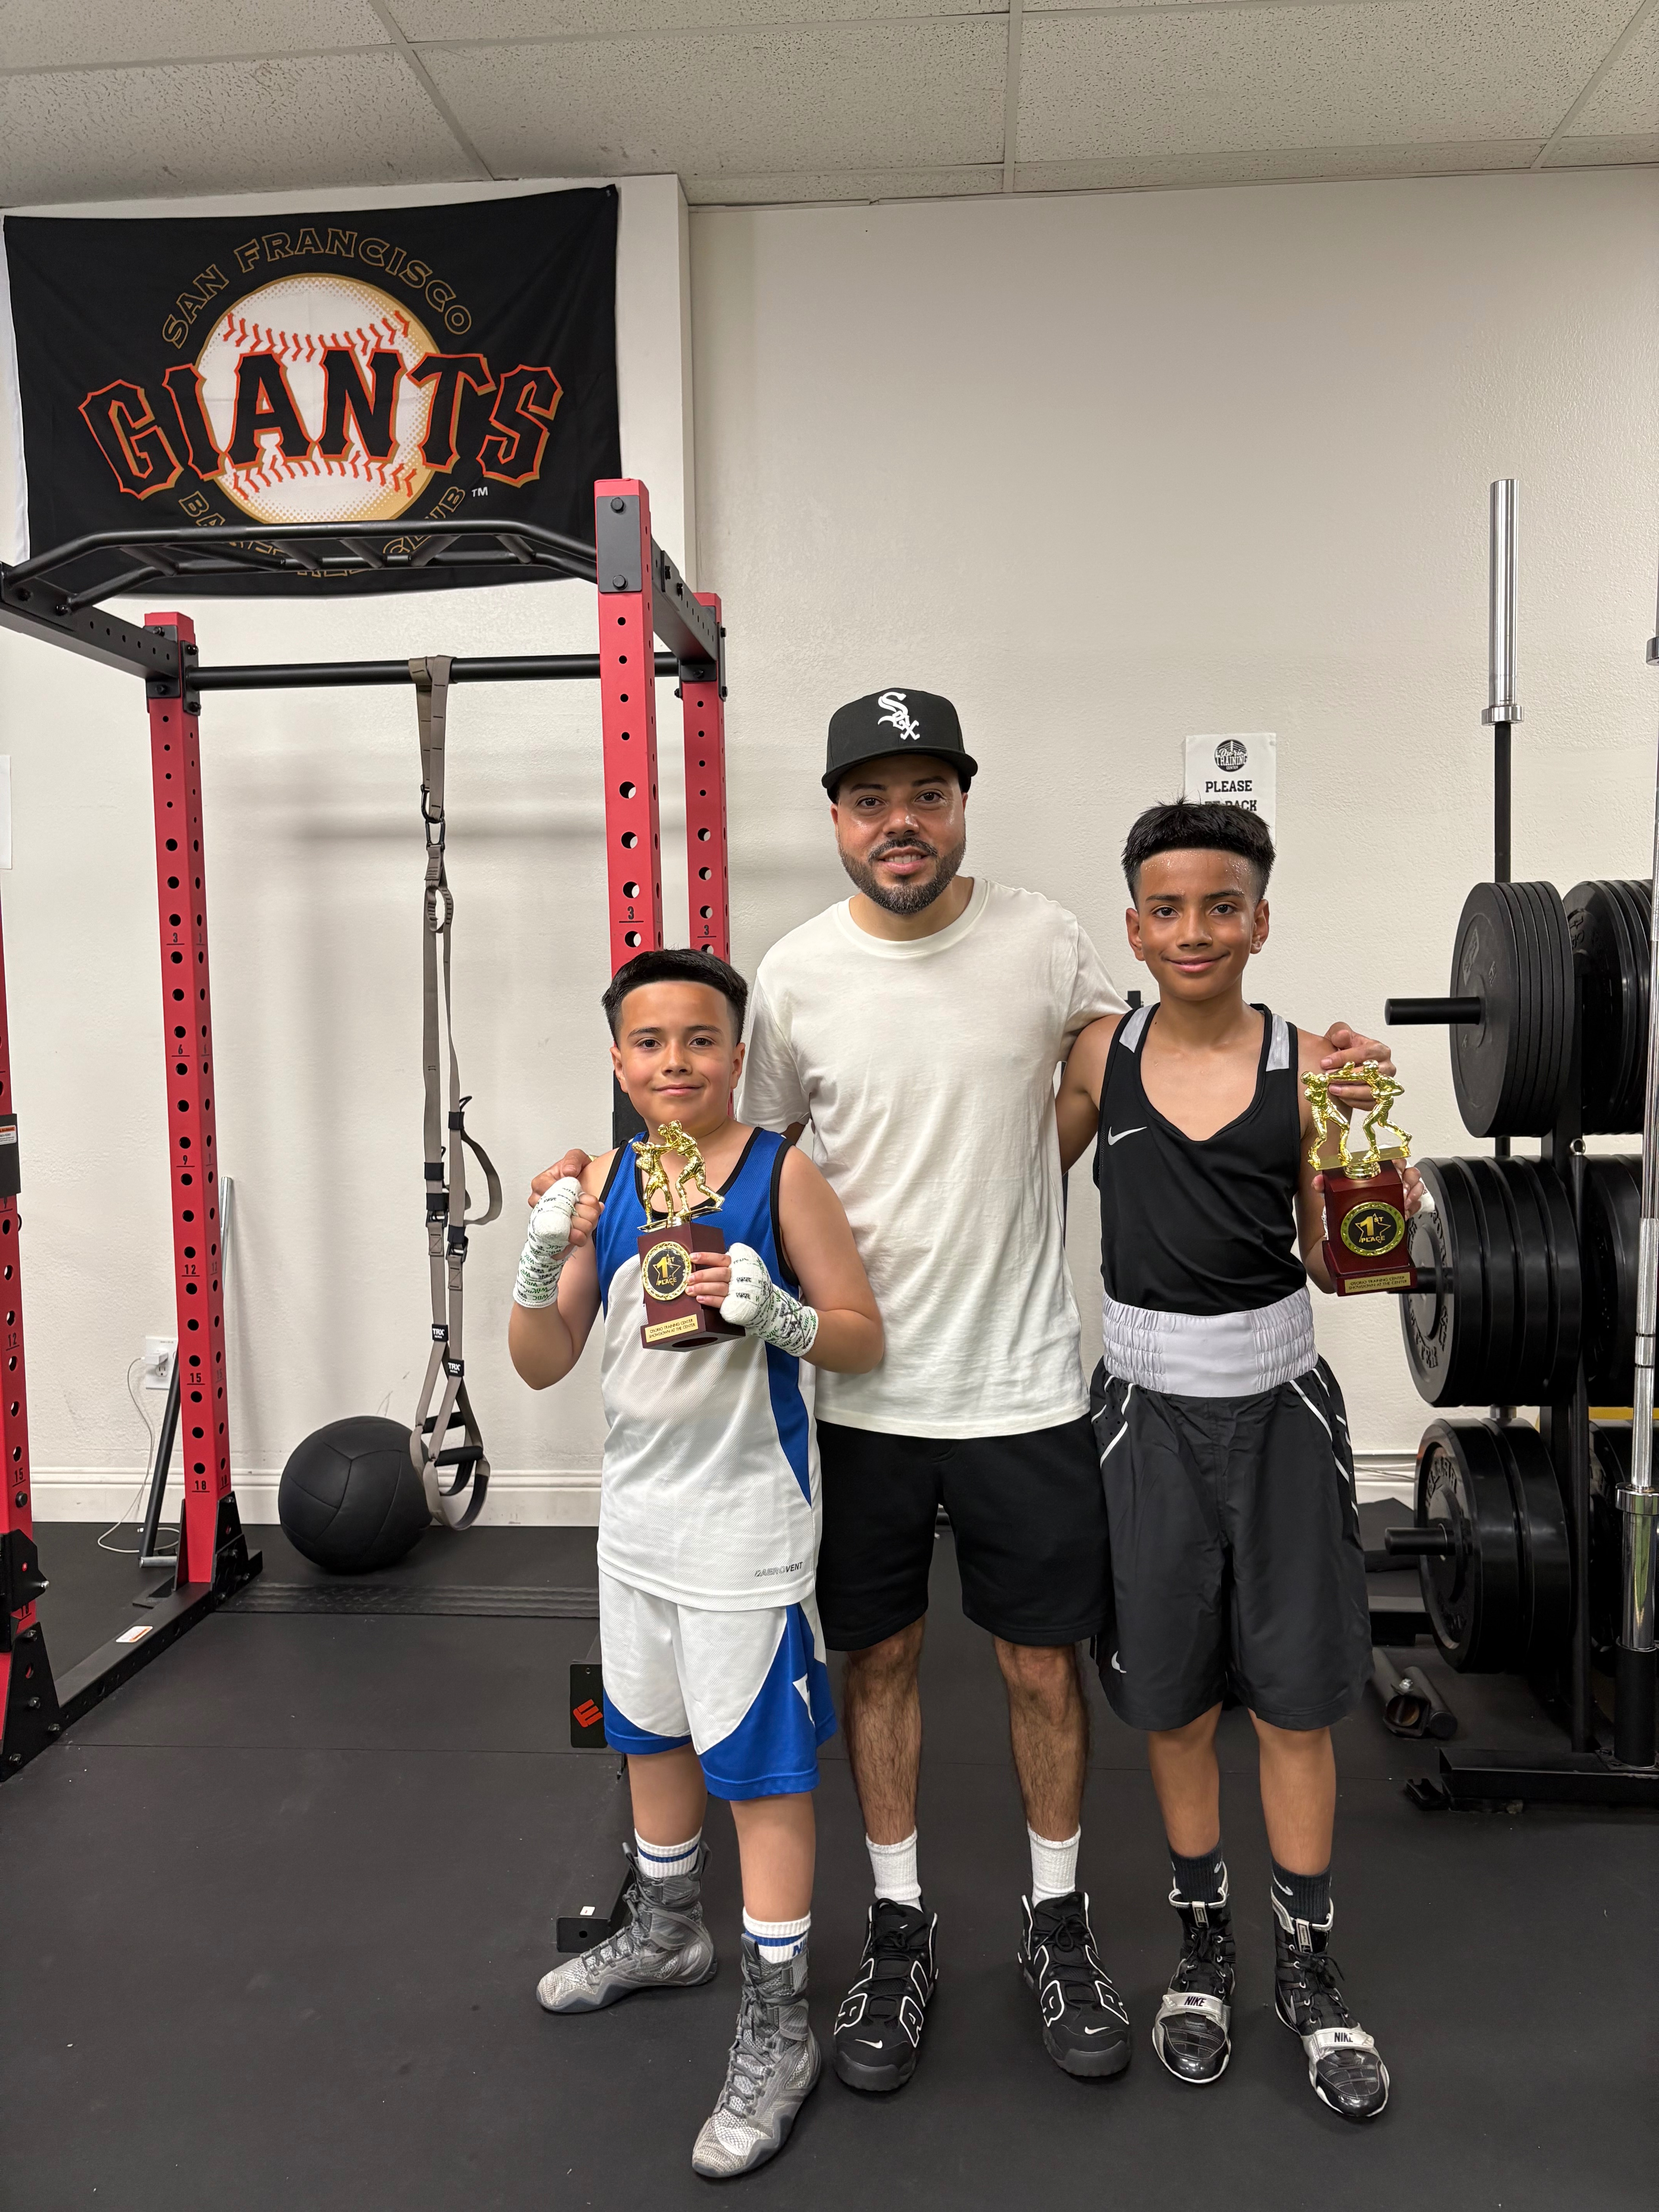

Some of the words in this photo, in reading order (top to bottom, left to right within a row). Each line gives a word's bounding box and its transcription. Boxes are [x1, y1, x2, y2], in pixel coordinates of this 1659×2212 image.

[163, 265, 229, 349] SAN
[235, 228, 472, 335] FRANCISCO
[77, 345, 564, 500] GIANTS
[1205, 780, 1252, 793] PLEASE
[627, 906, 634, 920] 3
[704, 925, 709, 936] 3
[173, 933, 178, 943] 3
[178, 1044, 183, 1054] 6
[182, 1155, 188, 1165] 9
[184, 1264, 197, 1274] 12
[658, 1277, 677, 1286] PLACE
[433, 1328, 445, 1336] TRX
[8, 1332, 17, 1347] 12
[448, 1362, 461, 1371] TRX
[190, 1372, 201, 1383] 15
[14, 1467, 24, 1483] 15
[195, 1480, 206, 1490] 18
[1184, 1996, 1207, 2007] NIKE
